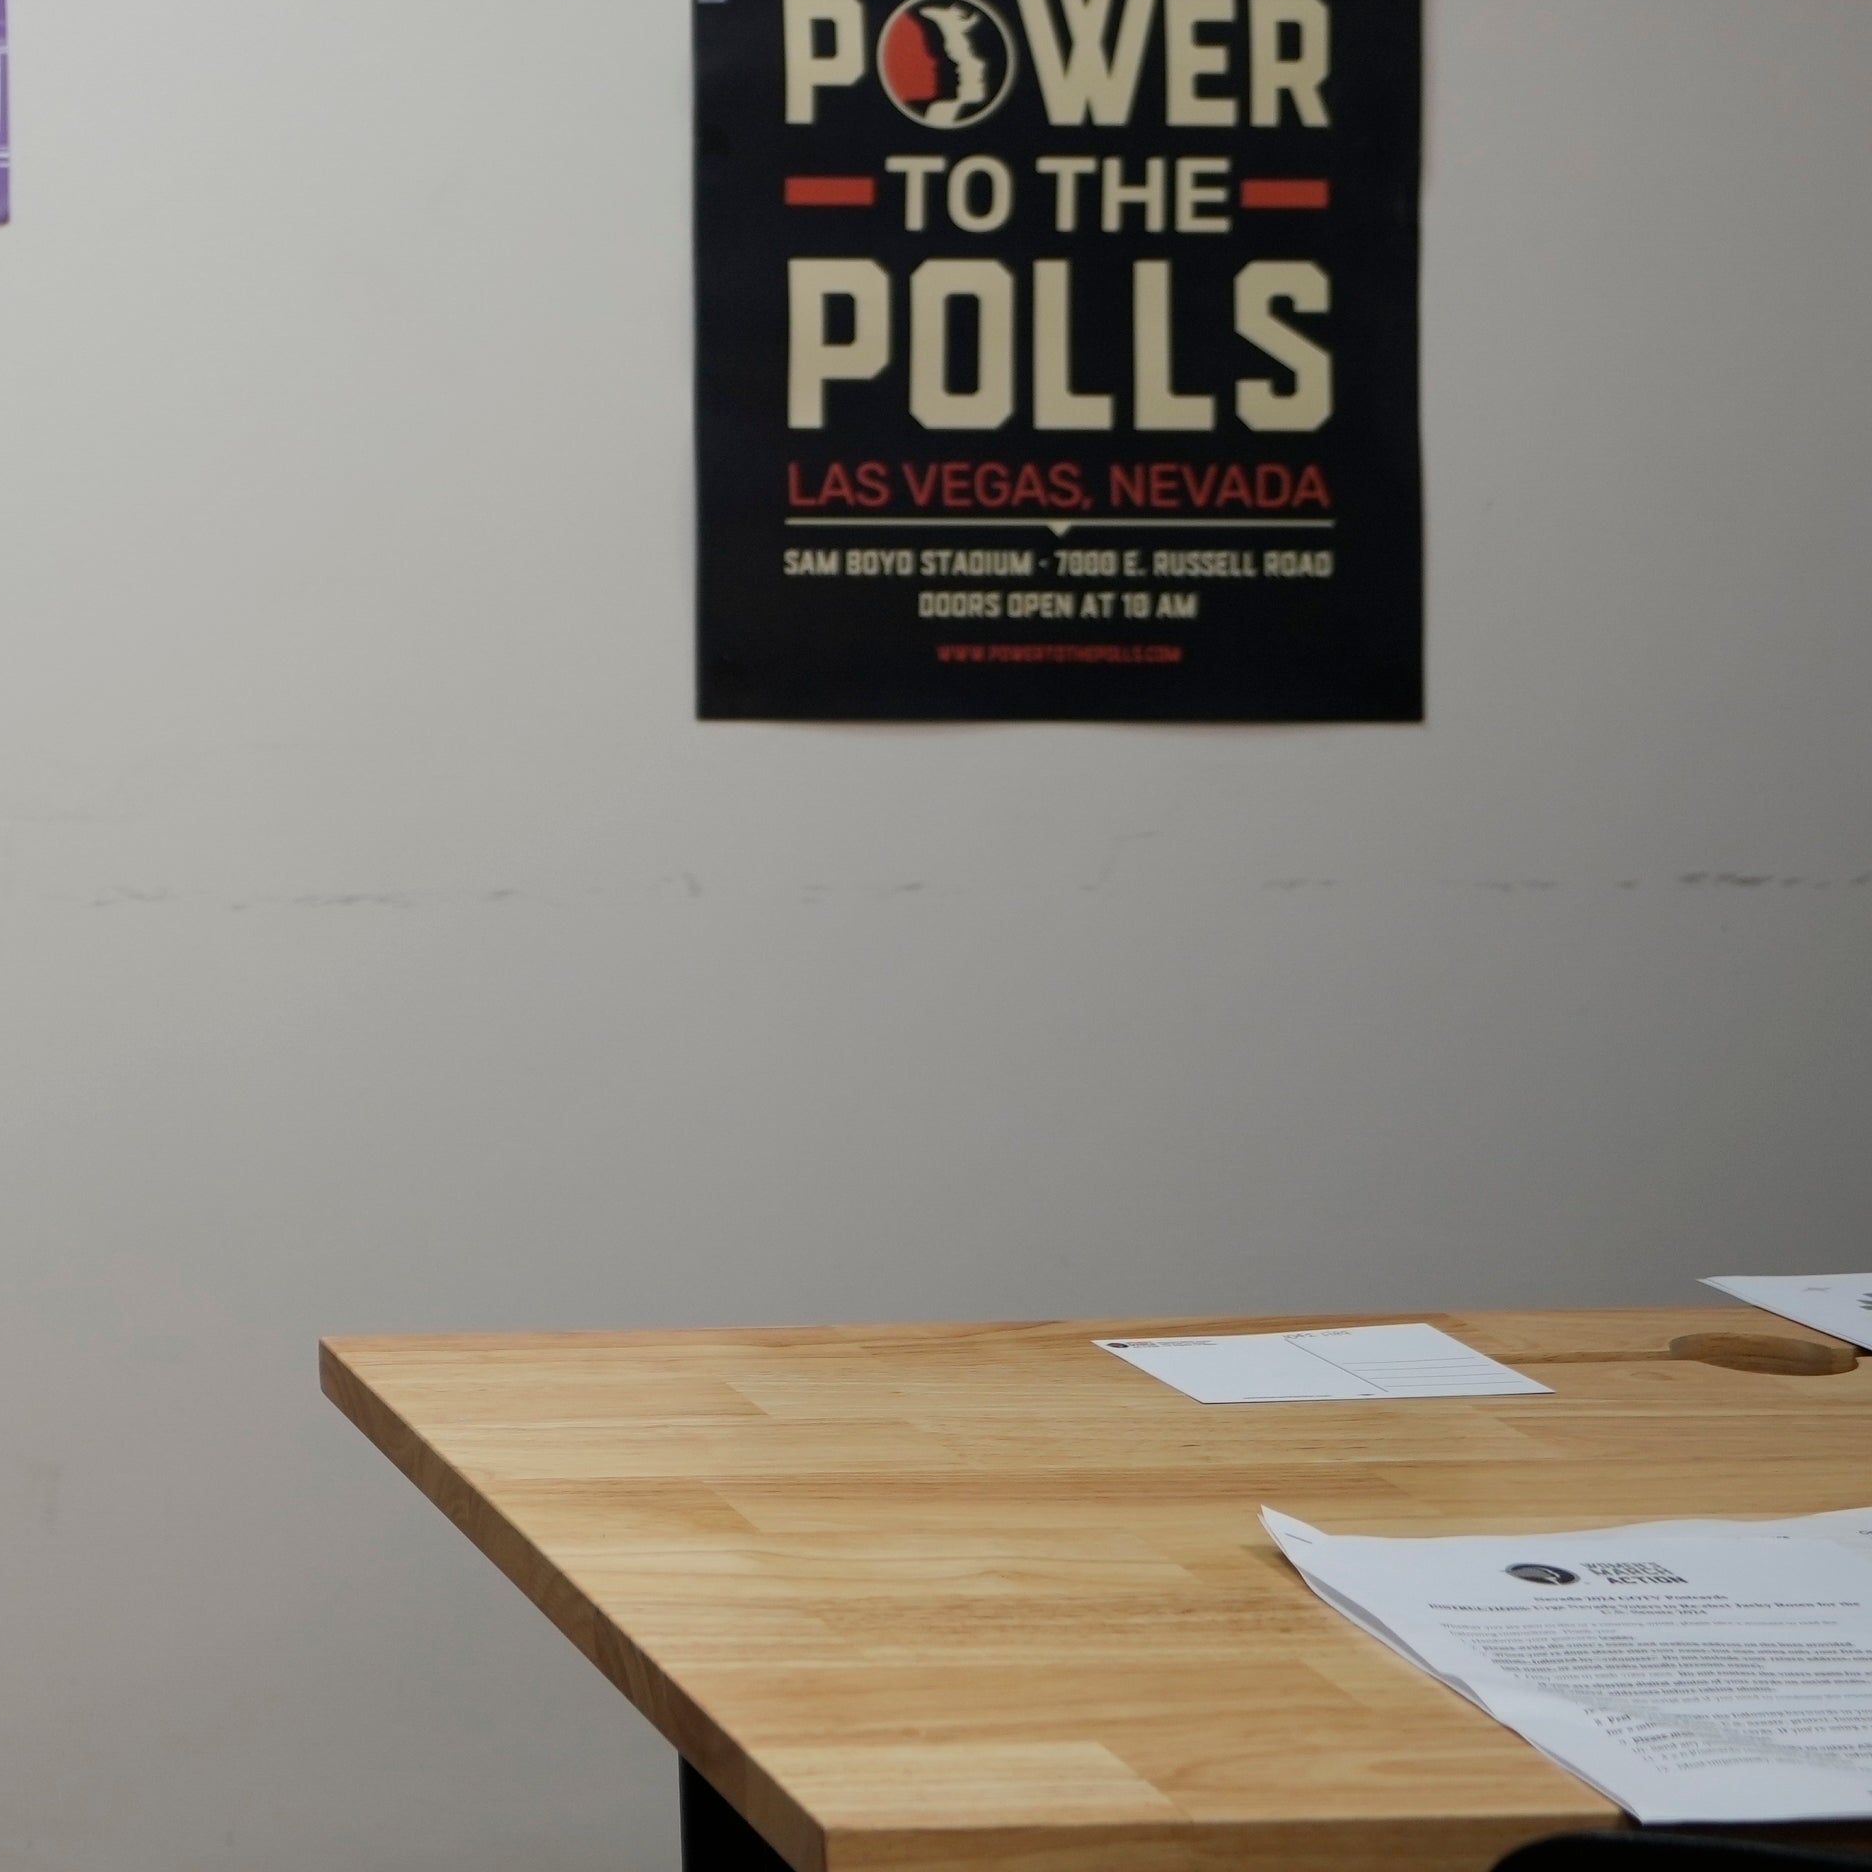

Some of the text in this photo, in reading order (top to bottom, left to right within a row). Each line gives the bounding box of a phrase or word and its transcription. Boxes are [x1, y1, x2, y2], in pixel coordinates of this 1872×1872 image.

[884, 154, 1234, 234] TO THE
[787, 257, 1335, 433] POLLS
[788, 461, 1332, 512] LAS VEGAS, NEVADA
[783, 548, 839, 576] SAM
[846, 548, 914, 576] BOYD
[920, 549, 1033, 576] STADIUM
[1054, 549, 1119, 577] 7000
[1153, 549, 1258, 578] RUSSELL
[1263, 549, 1334, 578] ROAD
[918, 592, 1198, 620] DOORS OPEN AT 10 AM
[1605, 1575, 1690, 1585] ACTION
